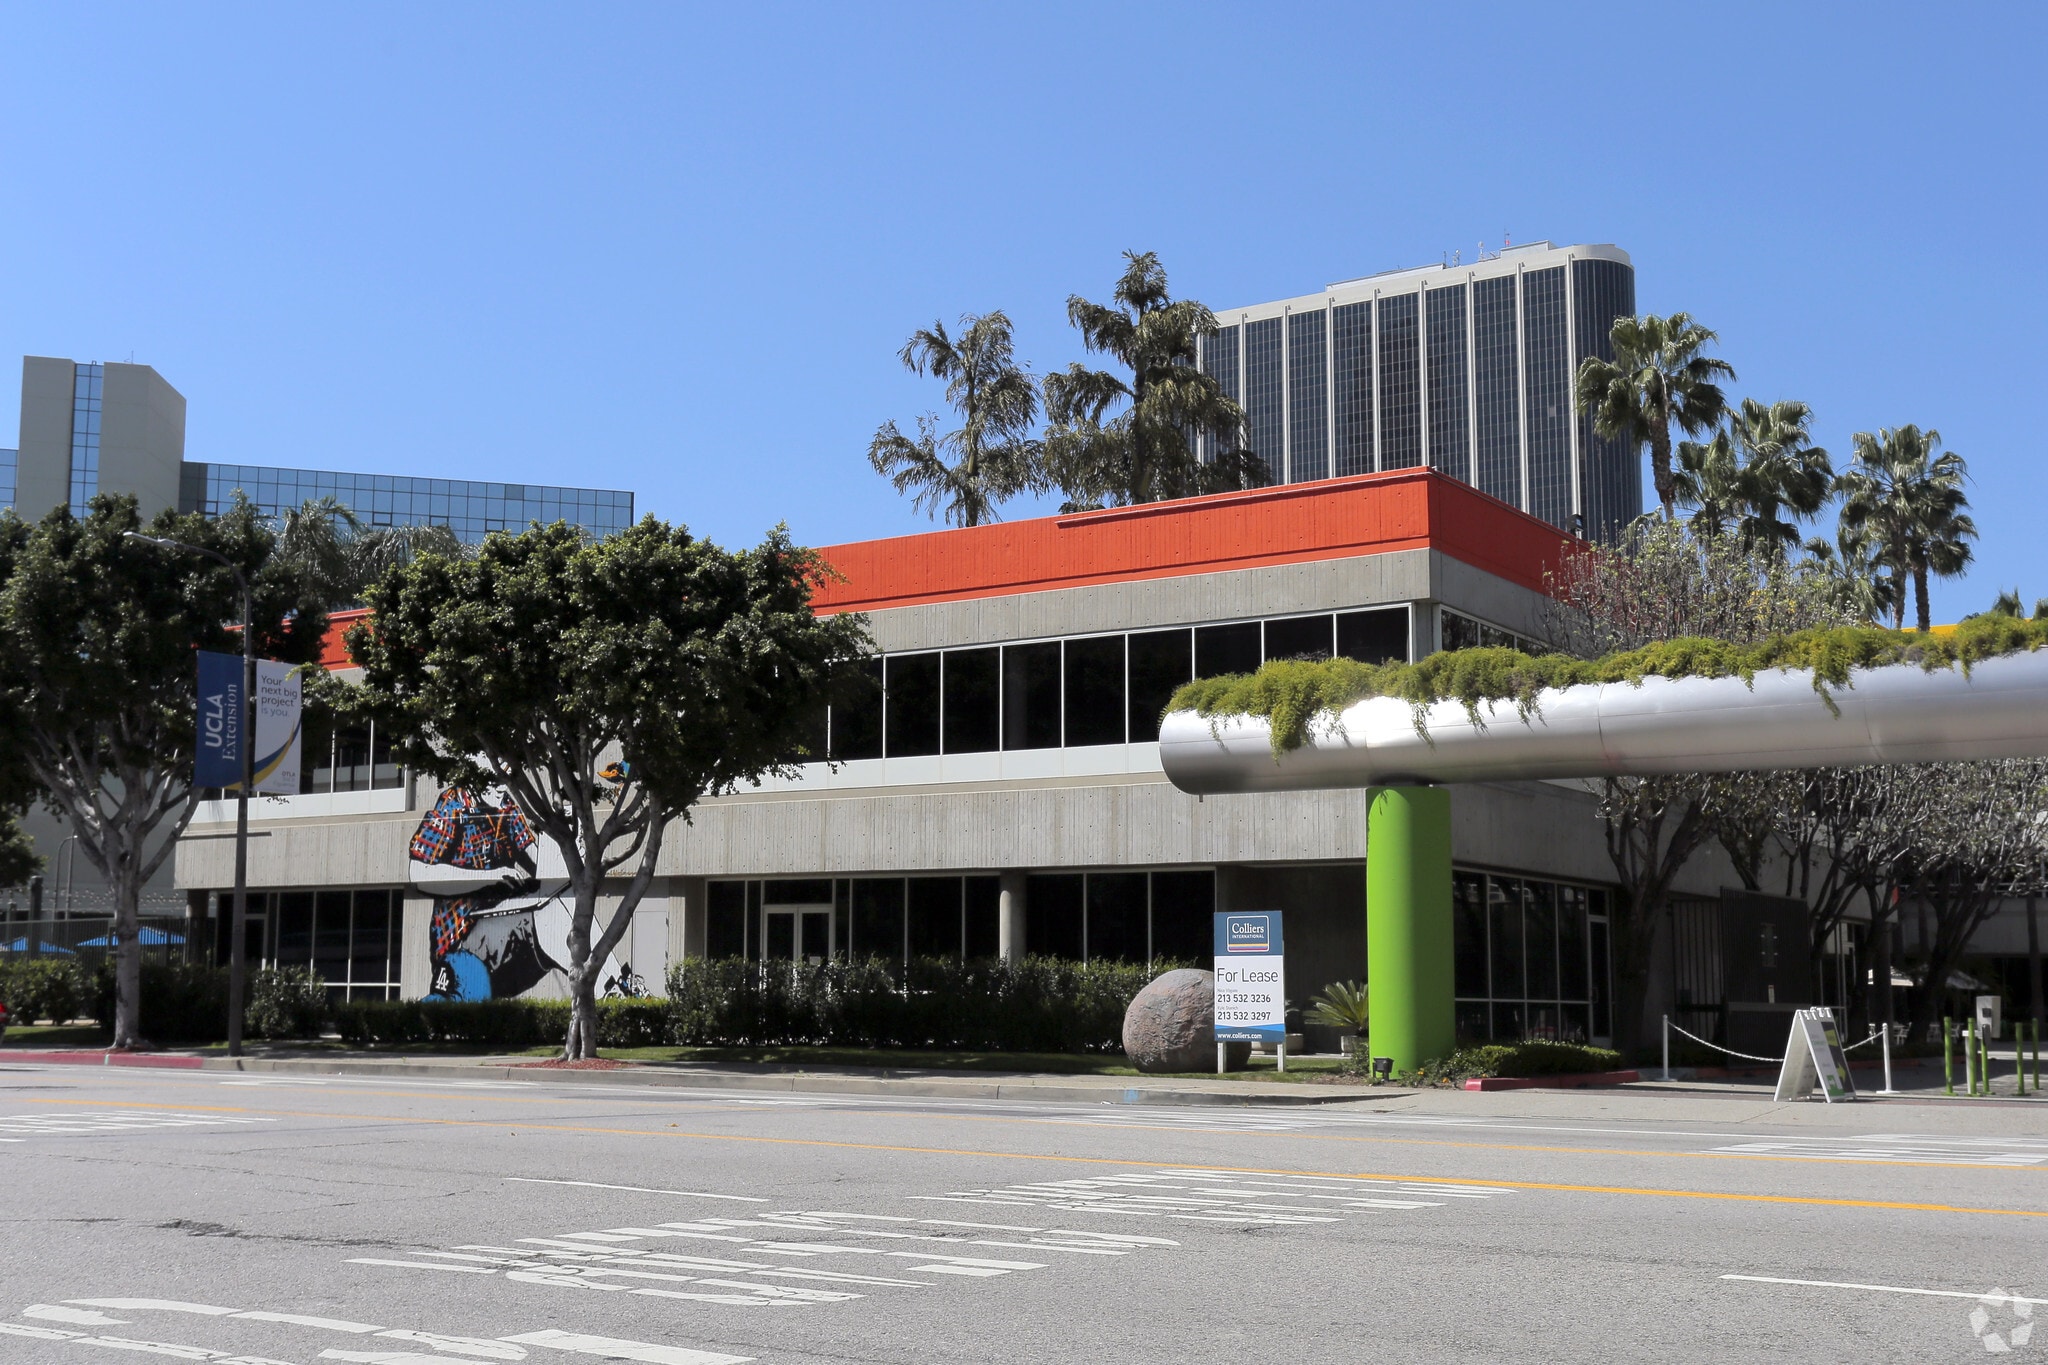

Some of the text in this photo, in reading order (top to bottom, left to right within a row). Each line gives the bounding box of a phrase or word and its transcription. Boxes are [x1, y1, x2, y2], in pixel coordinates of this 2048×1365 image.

[261, 675, 282, 686] Your
[261, 686, 298, 700] next big
[261, 696, 294, 708] project
[261, 707, 269, 715] is
[205, 694, 223, 748] UCLA
[222, 684, 238, 761] Extension
[1231, 922, 1265, 934] Colliers
[1217, 967, 1279, 983] For Lease
[1217, 993, 1271, 1003] 213 532 3236
[1217, 1011, 1271, 1021] 213 532 3297
[1216, 1032, 1263, 1040] www.colliers.com
